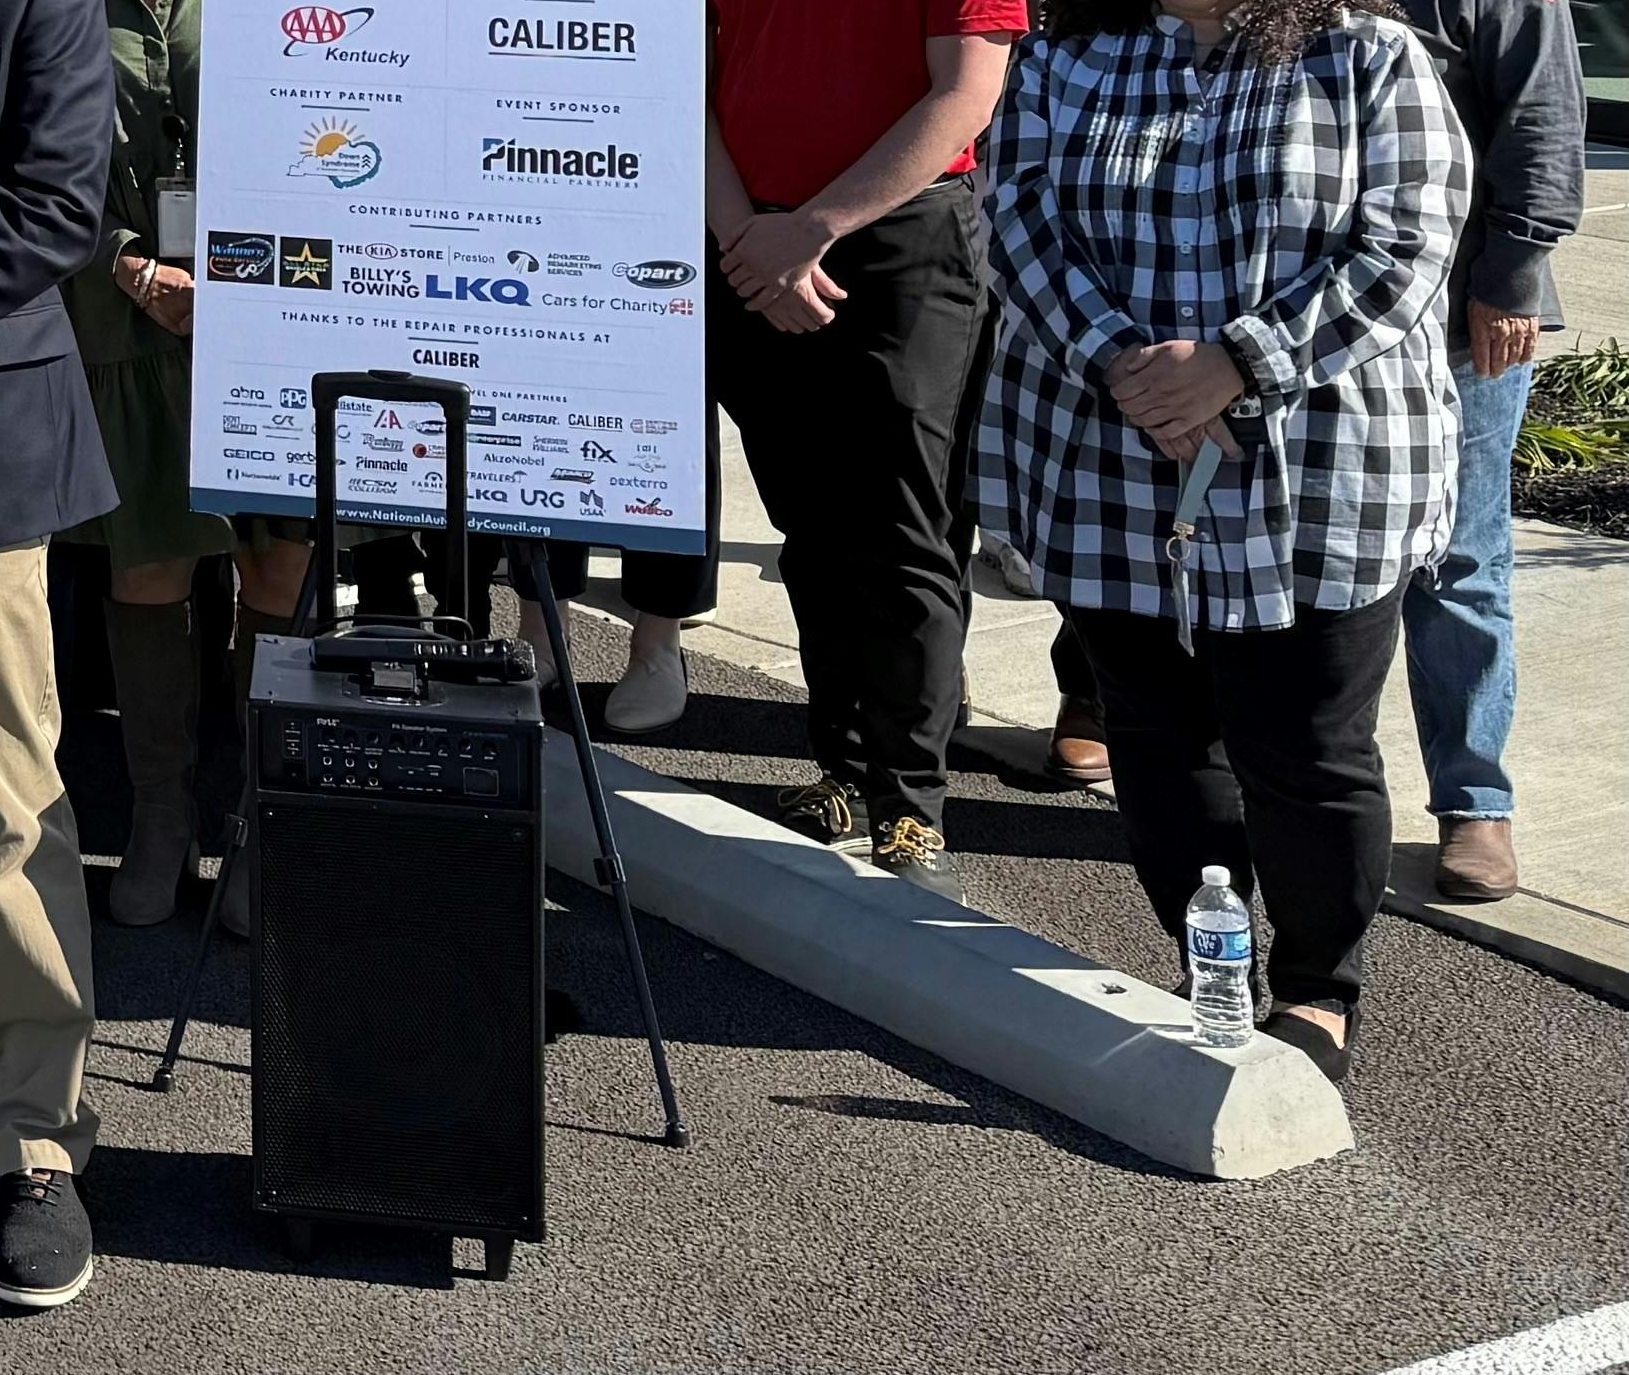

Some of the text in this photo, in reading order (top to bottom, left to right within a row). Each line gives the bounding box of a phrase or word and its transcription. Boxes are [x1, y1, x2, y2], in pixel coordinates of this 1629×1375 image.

[287, 7, 342, 43] AAA
[488, 17, 636, 53] CALIBER
[325, 46, 410, 68] Kentucky
[270, 88, 403, 103] CHARITY PARTNER
[496, 99, 621, 114] EVENT SPONSOR
[482, 138, 639, 180] Pinnacle
[482, 173, 639, 188] FINANCIAL PARTNERS
[349, 204, 542, 225] CONTRIBUTING PARTNERS
[338, 244, 444, 260] THE KIA STORE
[350, 266, 412, 284] BILLY'S
[612, 262, 686, 282] Copart
[342, 280, 420, 299] TOWING
[426, 274, 532, 307] LKQ
[542, 293, 668, 316] Cars for Charity
[282, 311, 611, 344] THANKS TO THE REPAIR PROFESSIONALS AT
[413, 348, 480, 369] CALIBER
[230, 386, 265, 400] abra
[281, 389, 306, 407] PPG
[568, 413, 623, 429] CALIBER
[223, 448, 275, 461] GEICO
[356, 456, 408, 472] Pinnacle
[484, 453, 545, 466] AkzoNobel
[520, 488, 566, 509] URG
